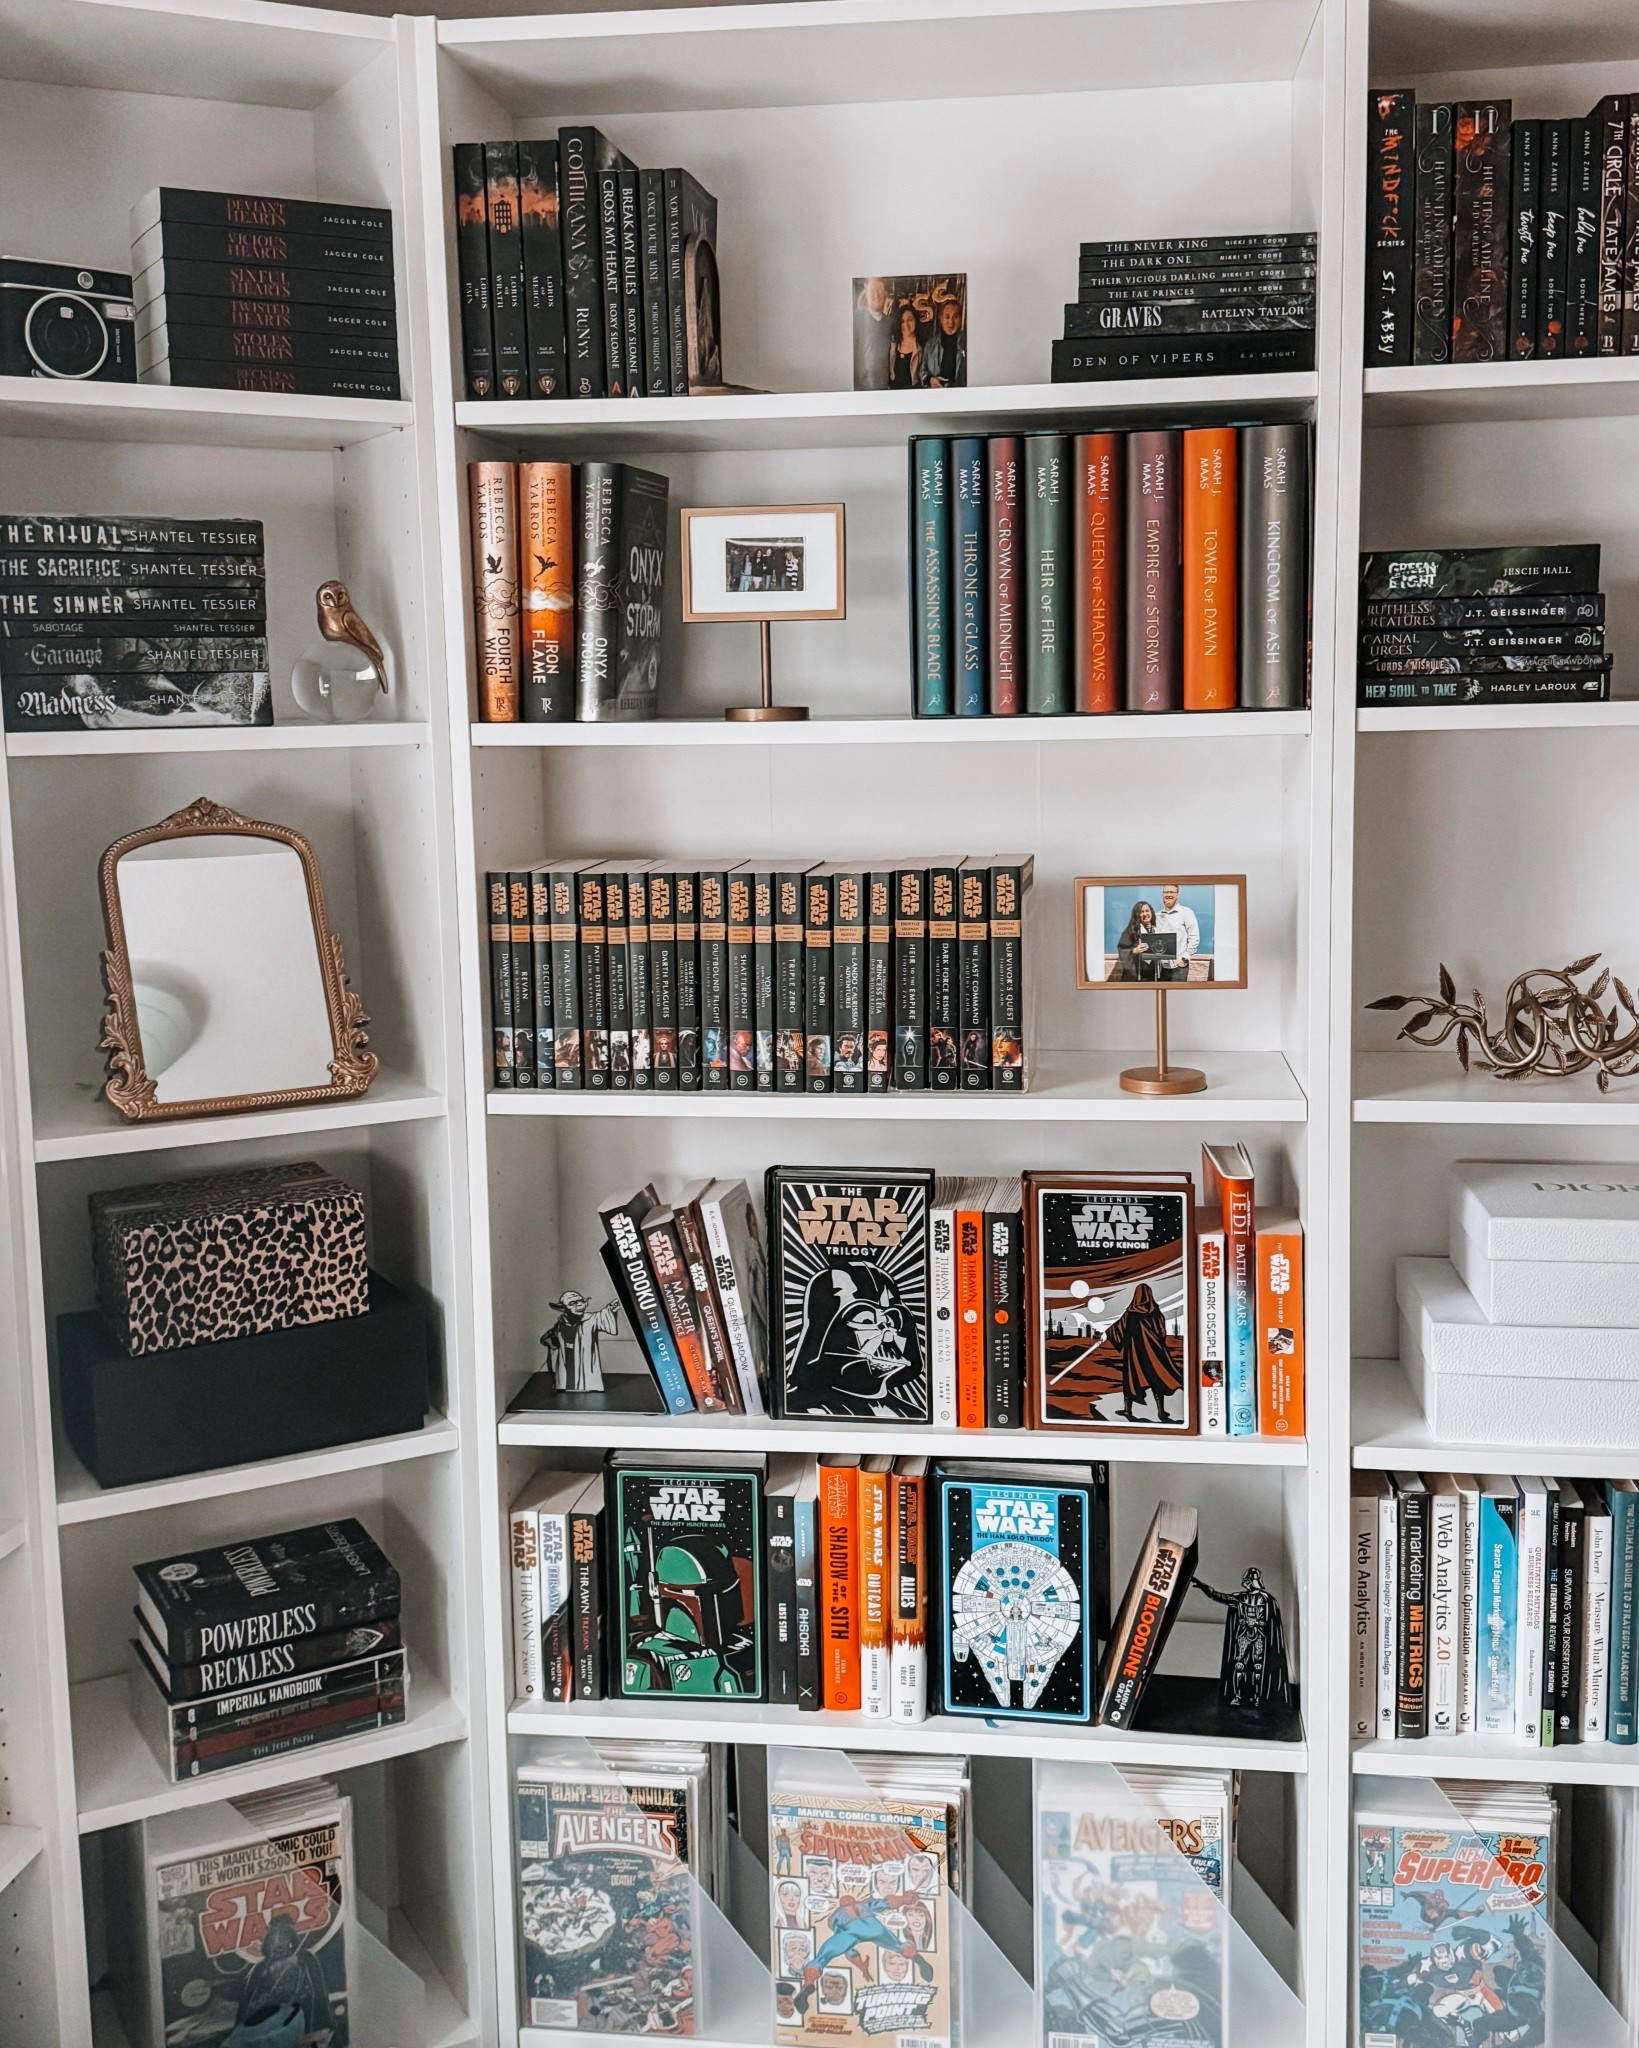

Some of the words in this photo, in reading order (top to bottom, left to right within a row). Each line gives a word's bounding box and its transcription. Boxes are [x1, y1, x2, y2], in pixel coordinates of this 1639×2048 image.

[1608, 121, 1623, 141] 7TH
[1606, 146, 1623, 197] CIRCLE
[603, 179, 614, 222] CROSS
[622, 188, 633, 230] BREAK
[605, 226, 616, 248] MY
[624, 233, 635, 253] MY
[1106, 244, 1129, 252] THE
[1134, 242, 1174, 251] NEVER
[1179, 240, 1208, 249] KING
[1606, 219, 1618, 256] TATE
[325, 250, 358, 259] JAGGER
[362, 253, 384, 262] COLE
[606, 251, 617, 293] HEART
[625, 256, 636, 295] RULES
[1602, 261, 1616, 312] JAMES
[328, 316, 361, 325] JAGGER
[366, 318, 387, 327] COLE
[1100, 306, 1162, 328] GRAVES
[1202, 309, 1255, 318] KATELYN
[1259, 306, 1304, 317] TAYLOR
[233, 333, 292, 348] STOLEN
[576, 308, 589, 358] RUNYX
[1379, 307, 1394, 354] ABBY
[234, 345, 293, 360] HEARTS
[1073, 357, 1107, 366] DEN
[1119, 355, 1139, 364] OF
[1151, 353, 1214, 363] VIPERS
[1142, 463, 1151, 495] MAAS
[1155, 454, 1164, 488] SARAH
[477, 483, 488, 539] YARROS
[493, 477, 504, 545] REBECCA
[1155, 490, 1164, 503] J.
[1090, 513, 1105, 570] QUEEN
[1204, 529, 1217, 585] TOWER
[38, 559, 120, 576] SACRIFICE
[131, 564, 195, 575] SHANTEL
[202, 565, 256, 576] TESSIER
[1040, 550, 1054, 588] HEIR
[1267, 521, 1280, 602] KINGDOM
[1504, 568, 1539, 577] JESCIE
[1543, 566, 1571, 574] HALL
[1093, 577, 1101, 594] OF
[1205, 589, 1212, 603] OF
[0, 596, 38, 614] THE
[54, 596, 124, 613] SINNER
[1041, 595, 1052, 613] OF
[1266, 609, 1275, 625] OF
[1466, 610, 1485, 618] J.T.
[1490, 608, 1564, 616] GEISSINGER
[33, 624, 84, 632] SABOTAGE
[1041, 619, 1054, 654] FIRE
[1093, 599, 1105, 681] SHADOWS
[1204, 609, 1217, 656] DAWN
[485, 637, 497, 676] WING
[497, 629, 512, 683] FOURTH
[532, 630, 546, 684] FLAME
[546, 641, 559, 674] IRON
[580, 633, 594, 682] STORM
[595, 637, 607, 678] ONYX
[1266, 631, 1279, 663] ASH
[1365, 685, 1386, 698] HER
[1389, 685, 1417, 698] SOUL
[1433, 684, 1457, 696] TAKE
[901, 874, 911, 915] WARS
[911, 874, 919, 915] STAR
[1006, 994, 1014, 1022] QUEST
[798, 1198, 907, 1221] STAR
[1072, 1205, 1153, 1223] STAR
[1231, 1192, 1246, 1235] JEDI
[798, 1222, 907, 1246] WARS
[1072, 1223, 1153, 1241] WARS
[1117, 1241, 1149, 1249] KENOBI
[826, 1247, 877, 1256] TRILOGY
[1236, 1244, 1246, 1288] BATTLE
[627, 1260, 657, 1310] DOOKU
[1207, 1282, 1215, 1309] DARK
[671, 1281, 696, 1334] MASTER
[1236, 1291, 1246, 1326] SCARS
[645, 1311, 660, 1334] JEDI
[656, 1338, 670, 1362] LOST
[1207, 1312, 1216, 1358] DISCIPLE
[650, 1488, 725, 1504] STAR
[976, 1500, 1054, 1519] STAR
[650, 1505, 725, 1521] WARS
[976, 1516, 1054, 1534] WARS
[1026, 1535, 1054, 1543] TRILOGY
[1437, 1514, 1452, 1549] Web
[1464, 1521, 1474, 1553] Search
[830, 1526, 847, 1581] SHADOW
[1358, 1532, 1371, 1565] Web
[1406, 1527, 1421, 1600] marketing
[1461, 1556, 1473, 1593] Engine
[1564, 1569, 1572, 1610] SURVIVING
[520, 1574, 533, 1640] THRAWN
[840, 1586, 847, 1600] OF
[867, 1574, 881, 1623] OUTCAST
[900, 1576, 915, 1609] ALLIES
[1357, 1571, 1370, 1635] Analytics
[1434, 1554, 1451, 1631] Analytics
[200, 1603, 316, 1657] POWERLESS
[799, 1608, 809, 1656] AHSOKA
[831, 1607, 849, 1640] SITH
[1123, 1594, 1160, 1679] BLOODLINE
[1462, 1595, 1473, 1655] Optimization
[1563, 1614, 1571, 1635] YOUR
[1409, 1604, 1423, 1688] METRICS
[1437, 1637, 1450, 1660] 2.0
[1562, 1636, 1571, 1687] DISSERTATION
[200, 1643, 295, 1692] RECKLESS
[217, 1691, 266, 1716] IMPERIAL
[269, 1677, 322, 1703] HANDBOOK
[1114, 1683, 1125, 1705] GRAY
[1118, 1680, 1134, 1710] CLAUDIA
[798, 1808, 836, 1819] MARVEL
[839, 1810, 876, 1821] COMICS
[303, 1829, 335, 1848] COULD
[556, 1814, 678, 1862] AVENGERS
[823, 1822, 897, 1841] AMAZING
[200, 1873, 212, 1886] BE
[216, 1862, 255, 1882] WORTH
[292, 1850, 305, 1862] TO
[310, 1843, 333, 1858] YOU!
[855, 1992, 930, 2011] TURNING
[864, 2005, 917, 2022] POINT
